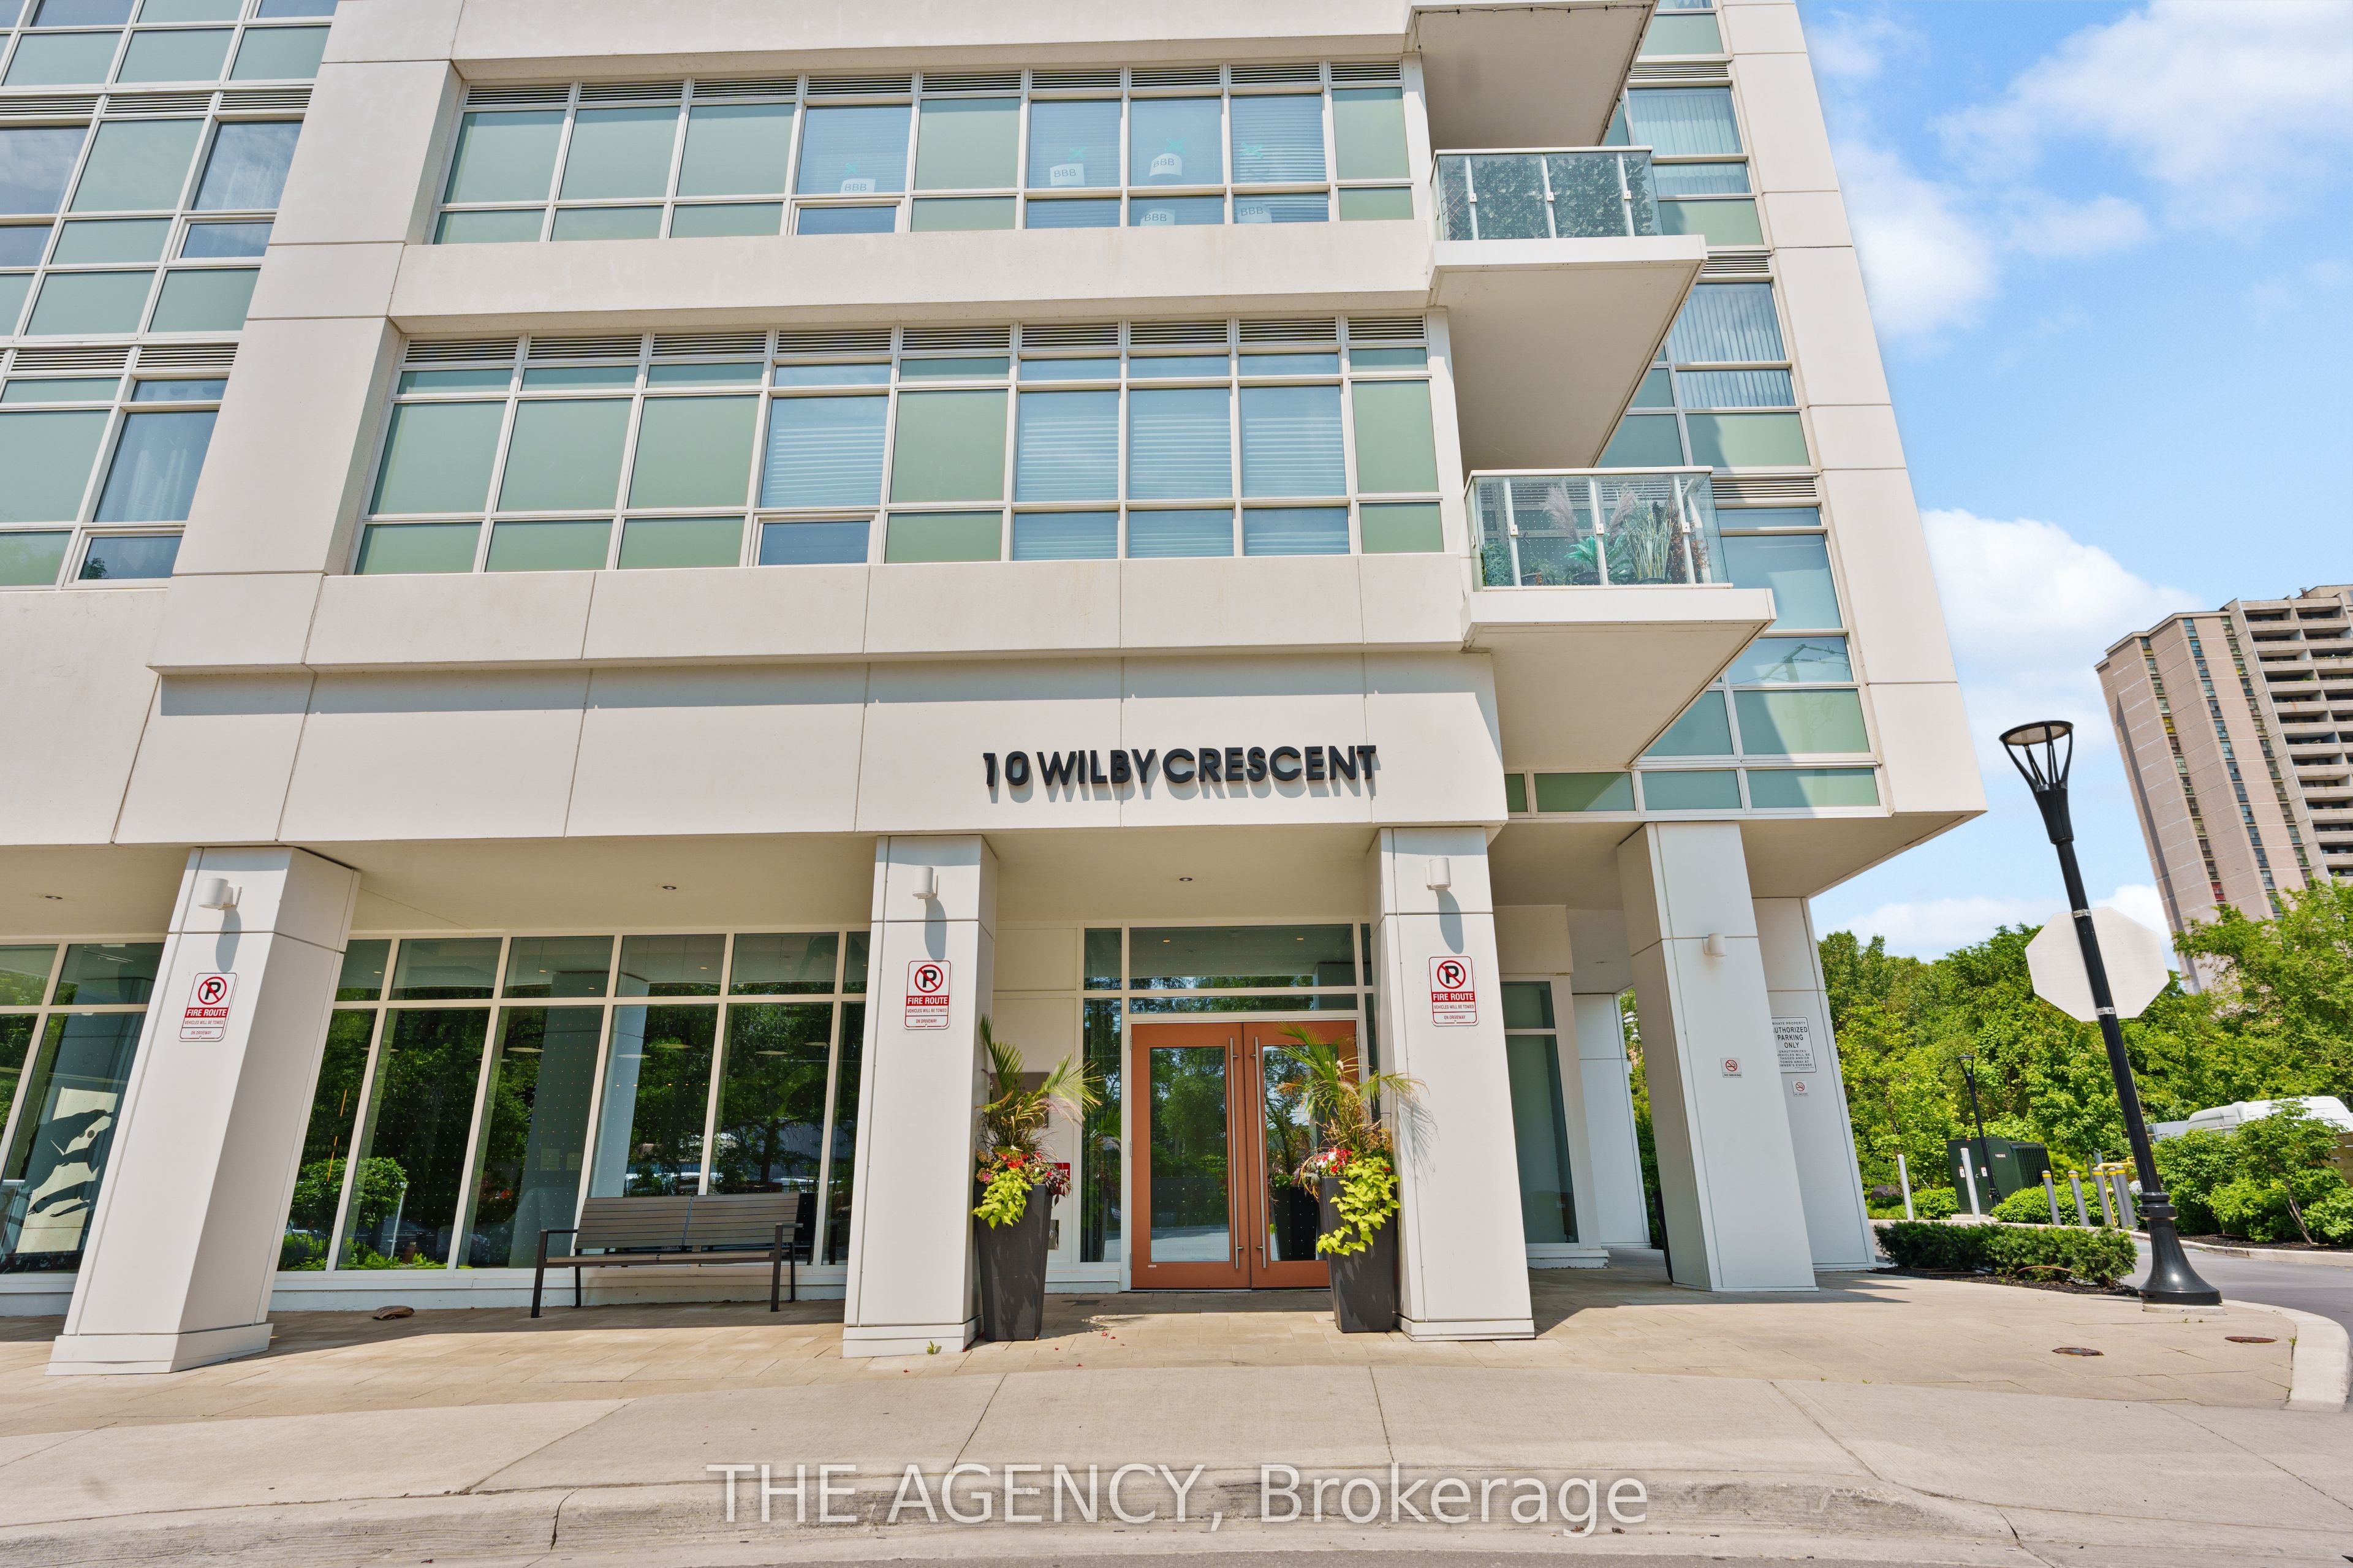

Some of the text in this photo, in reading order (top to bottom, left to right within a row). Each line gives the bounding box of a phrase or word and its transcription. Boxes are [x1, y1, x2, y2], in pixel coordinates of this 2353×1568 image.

[1153, 158, 1175, 168] BBB
[1241, 206, 1264, 216] BBB
[983, 745, 1376, 787] 10 WILBY CRESCENT
